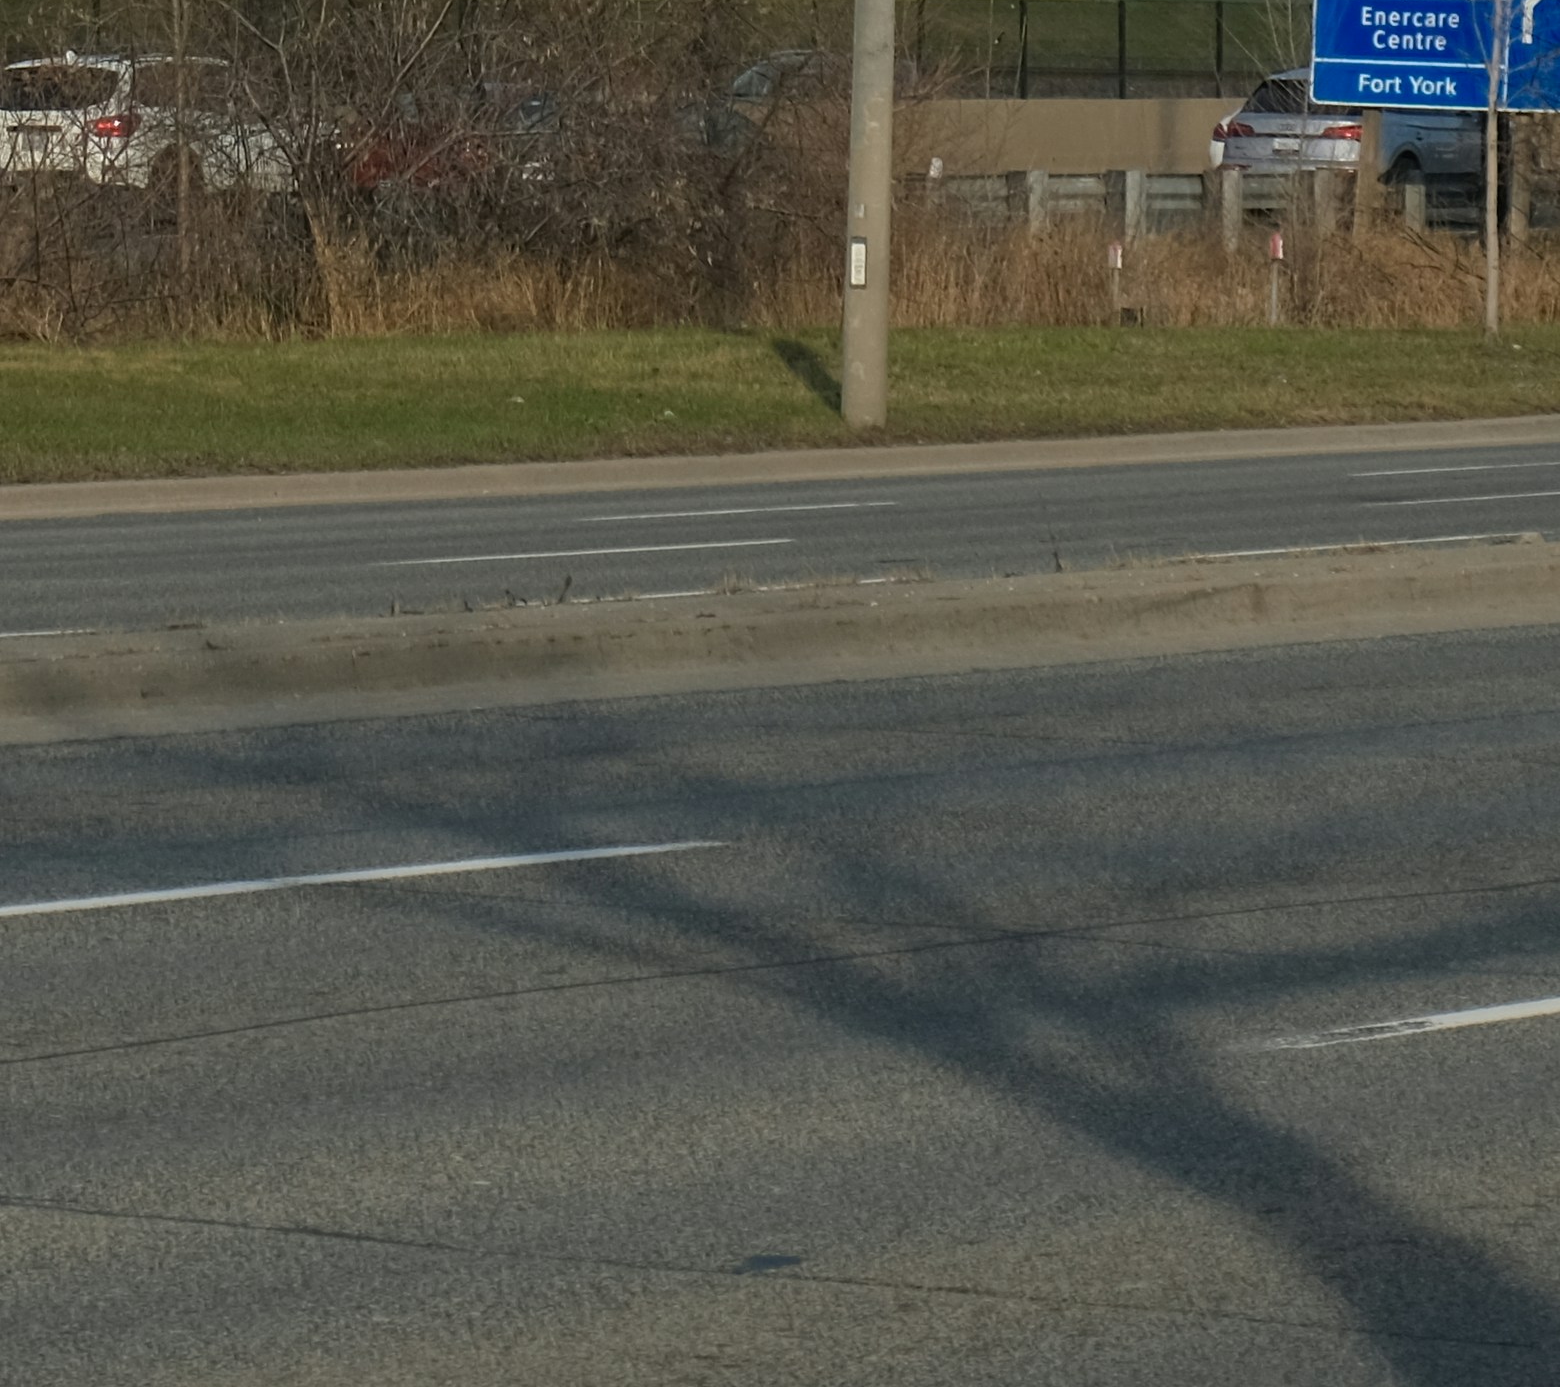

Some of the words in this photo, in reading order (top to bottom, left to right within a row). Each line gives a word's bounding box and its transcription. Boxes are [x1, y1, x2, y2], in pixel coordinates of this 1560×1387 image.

[1361, 6, 1460, 28] Enercare
[1372, 30, 1447, 51] Centre
[1358, 74, 1402, 94] Fort
[1409, 76, 1457, 96] York
